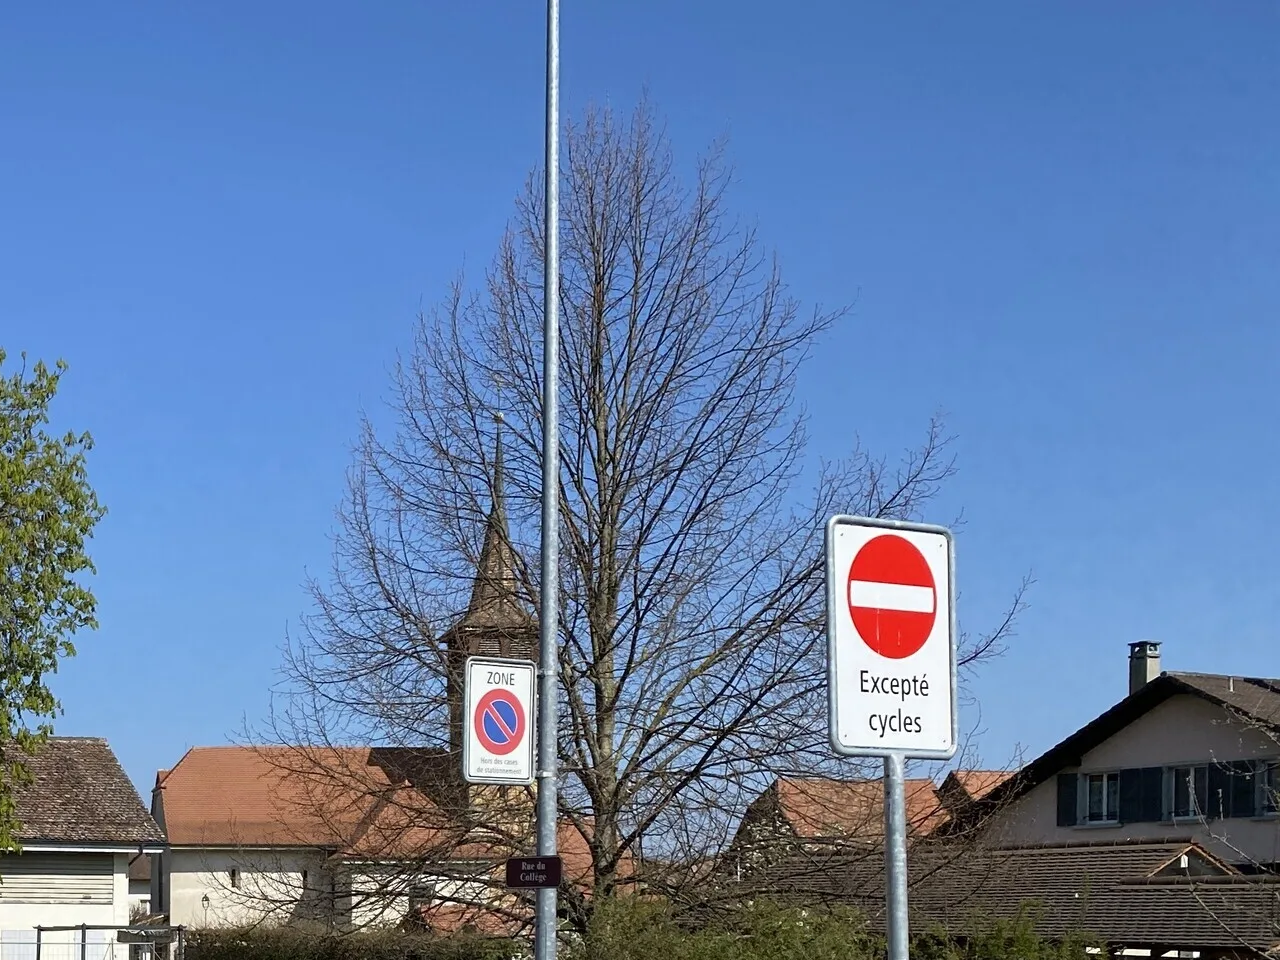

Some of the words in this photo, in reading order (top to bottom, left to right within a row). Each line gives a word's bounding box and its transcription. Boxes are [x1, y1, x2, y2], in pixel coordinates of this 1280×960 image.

[486, 671, 515, 686] ZONE
[860, 670, 929, 701] Excepté
[869, 708, 922, 738] cycles
[521, 861, 535, 870] Rue
[537, 861, 546, 870] du
